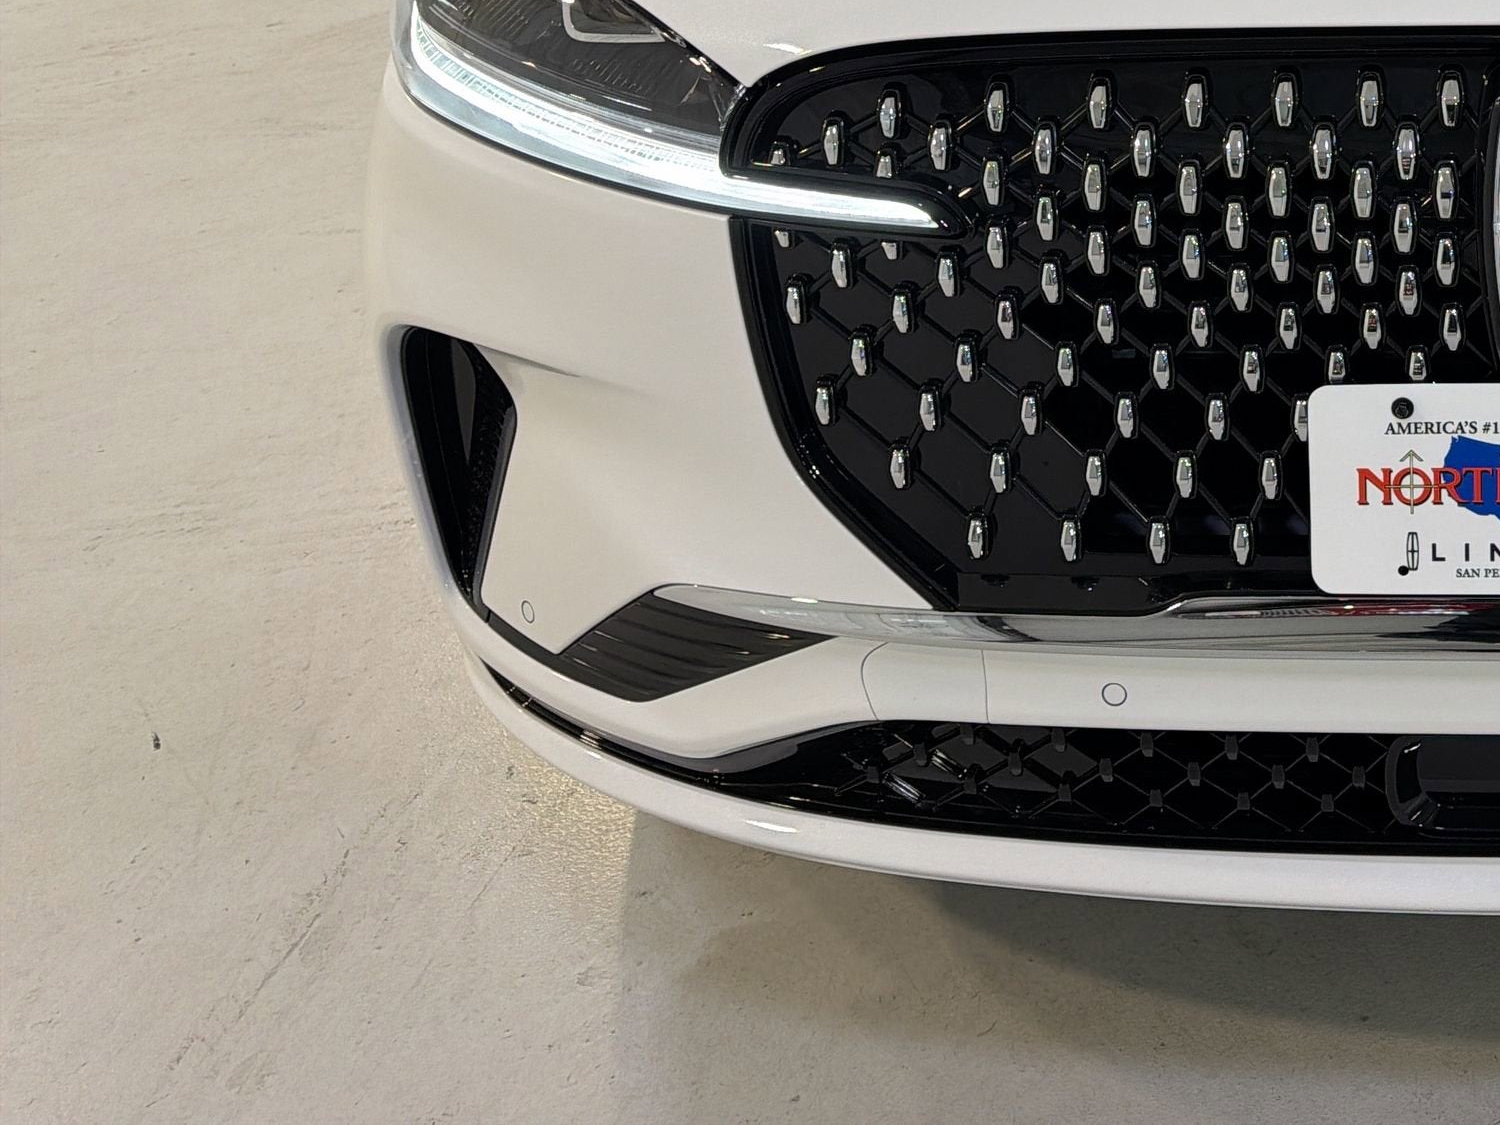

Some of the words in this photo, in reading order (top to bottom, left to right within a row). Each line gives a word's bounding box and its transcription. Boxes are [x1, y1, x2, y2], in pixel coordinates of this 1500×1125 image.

[1384, 421, 1478, 435] AMERICA'S
[1482, 421, 1500, 435] #1
[1455, 568, 1481, 579] SAN
